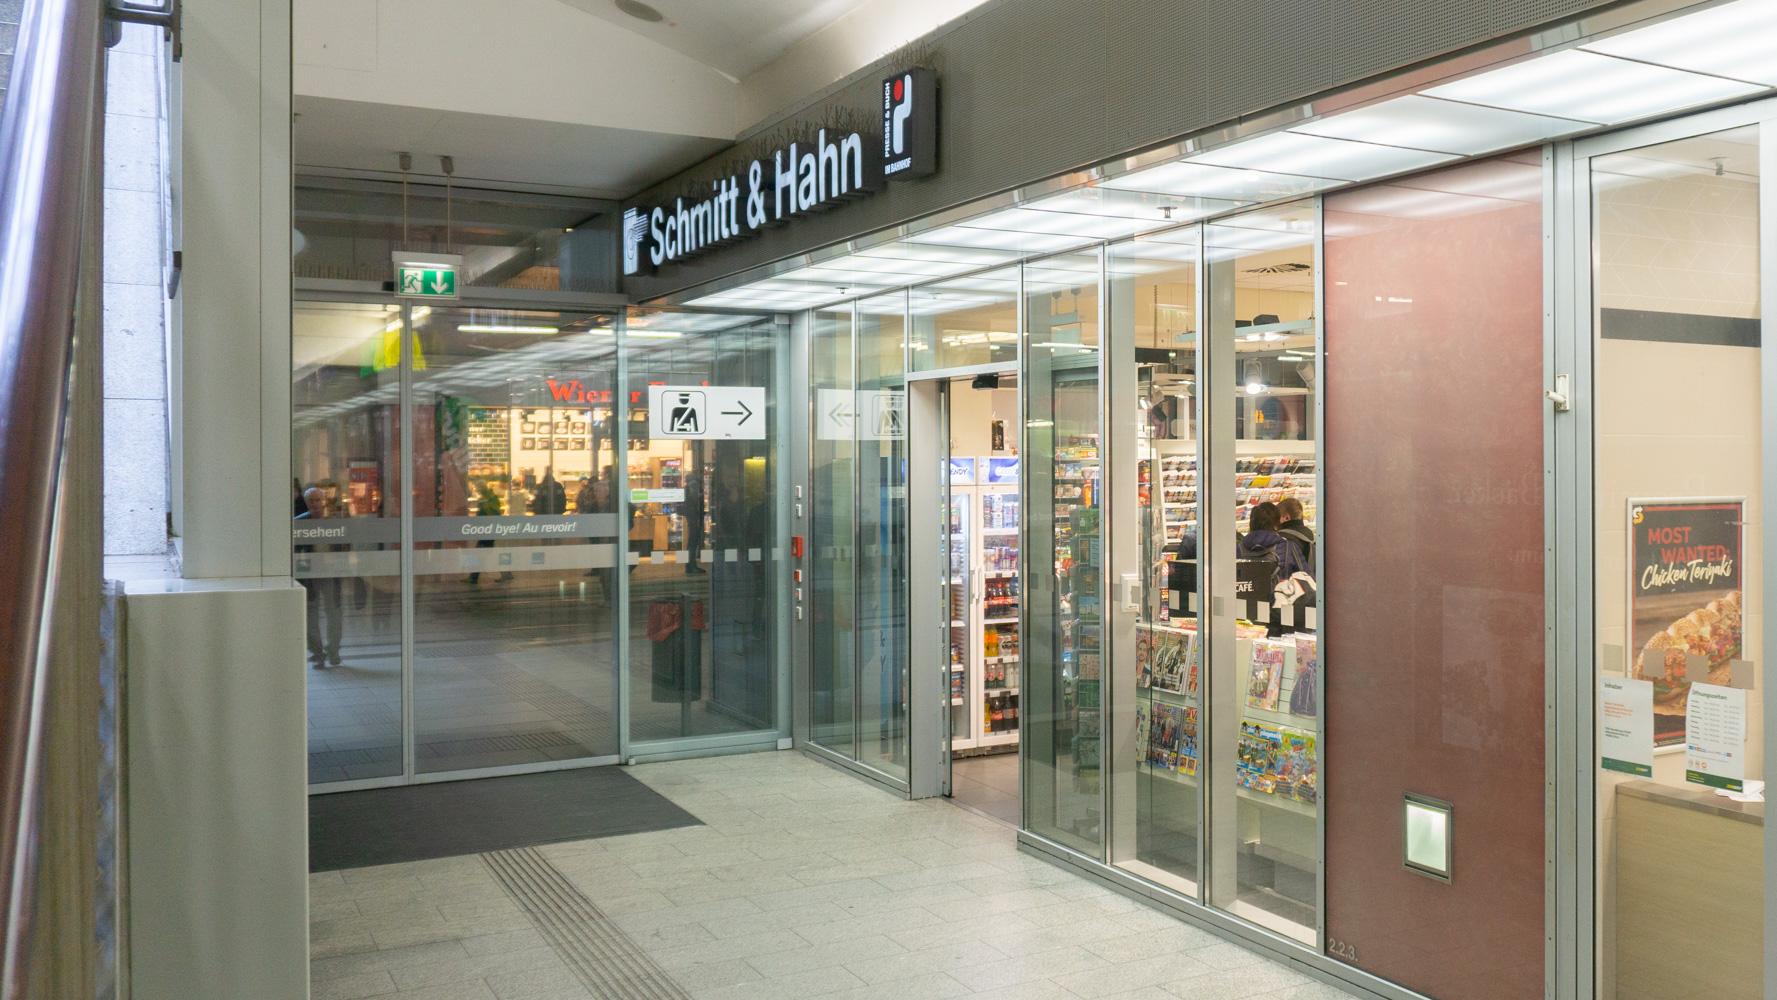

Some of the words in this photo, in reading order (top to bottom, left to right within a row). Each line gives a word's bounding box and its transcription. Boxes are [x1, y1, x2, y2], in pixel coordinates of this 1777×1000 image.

[884, 110, 890, 119] &
[890, 157, 912, 173] BAHNHOF
[650, 174, 740, 266] Schmitt
[746, 159, 767, 230] &
[775, 128, 863, 219] Hahn
[461, 523, 492, 536] Good
[495, 522, 520, 536] bye!
[522, 523, 539, 533] Au
[541, 521, 577, 533] revoir!
[1648, 527, 1691, 545] MOST
[1641, 562, 1688, 590] Chicken
[1687, 554, 1733, 585] Teriyaki
[1328, 938, 1359, 962] 2.2.3.
